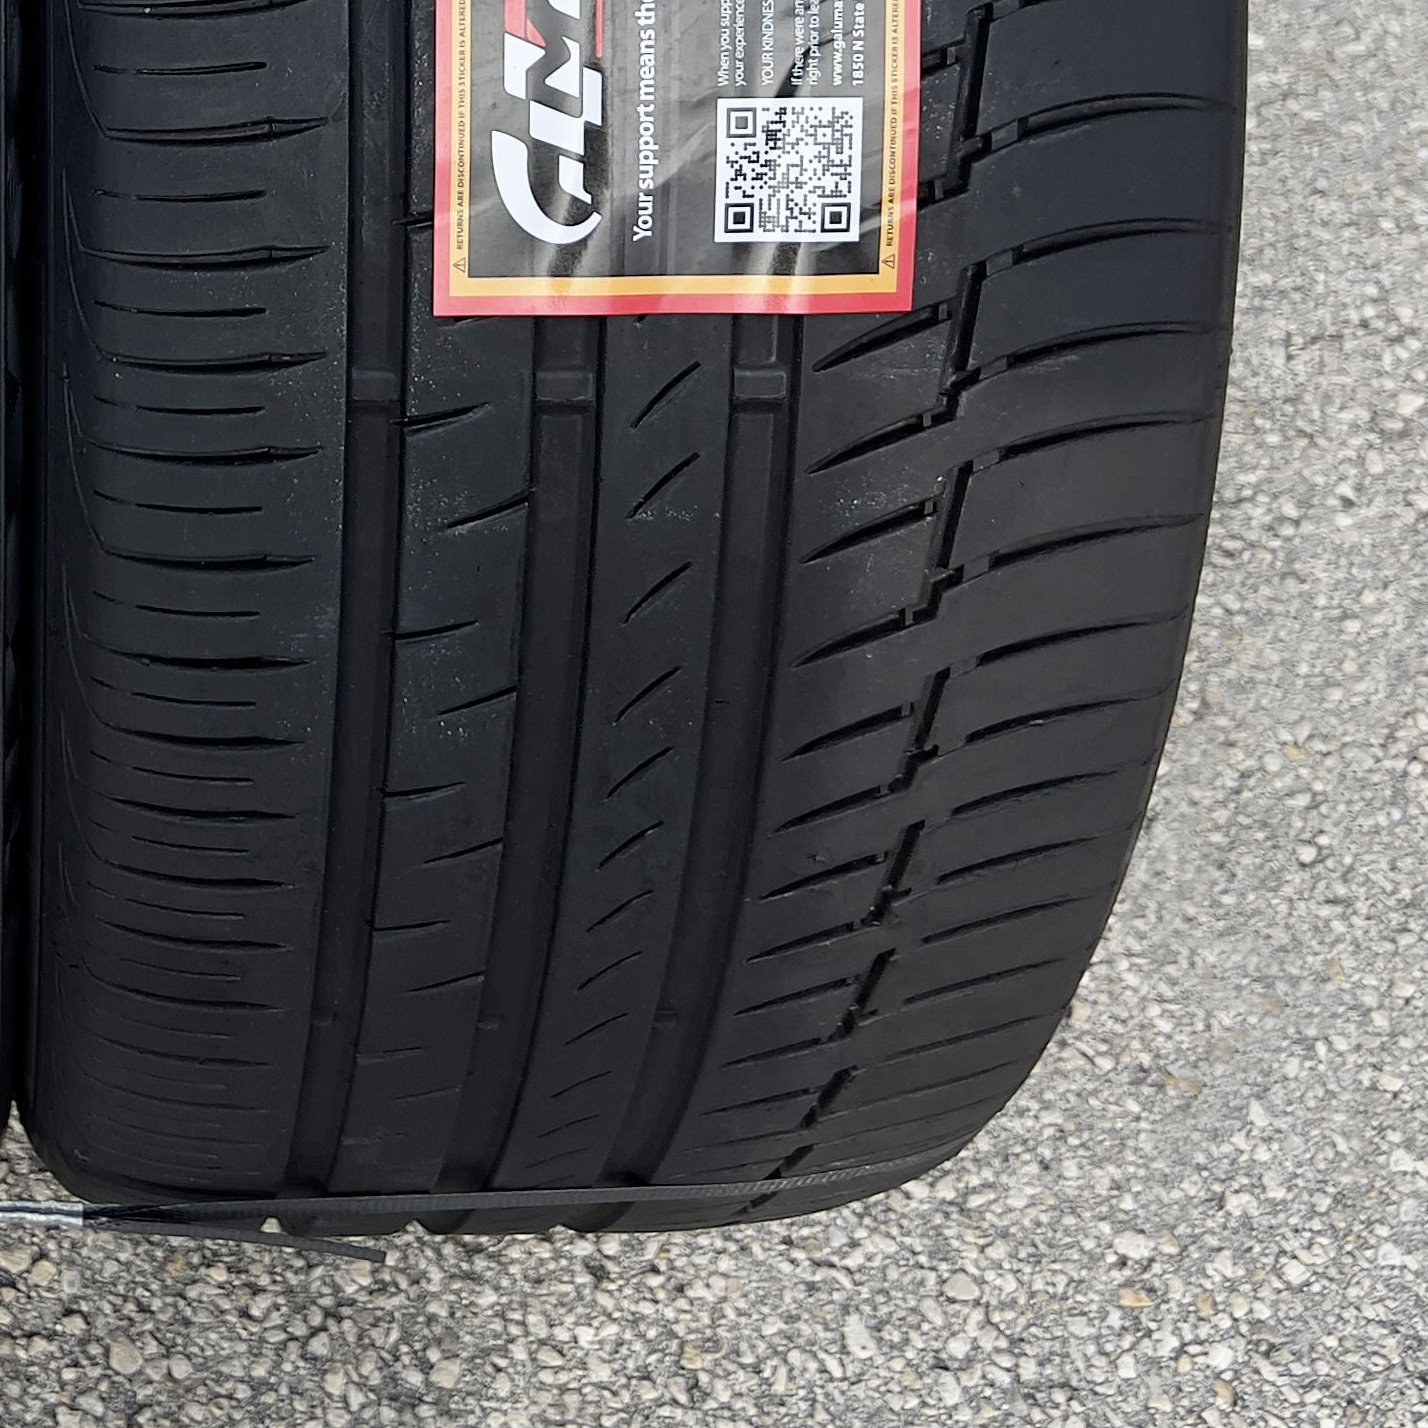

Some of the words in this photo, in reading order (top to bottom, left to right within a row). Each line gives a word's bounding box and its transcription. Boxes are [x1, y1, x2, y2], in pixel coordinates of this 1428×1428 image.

[851, 2, 864, 38] State
[851, 40, 864, 51] N
[637, 28, 655, 101] means
[761, 52, 774, 86] YOUR
[851, 53, 864, 86] 1850
[631, 103, 659, 192] support
[631, 190, 654, 241] Your
